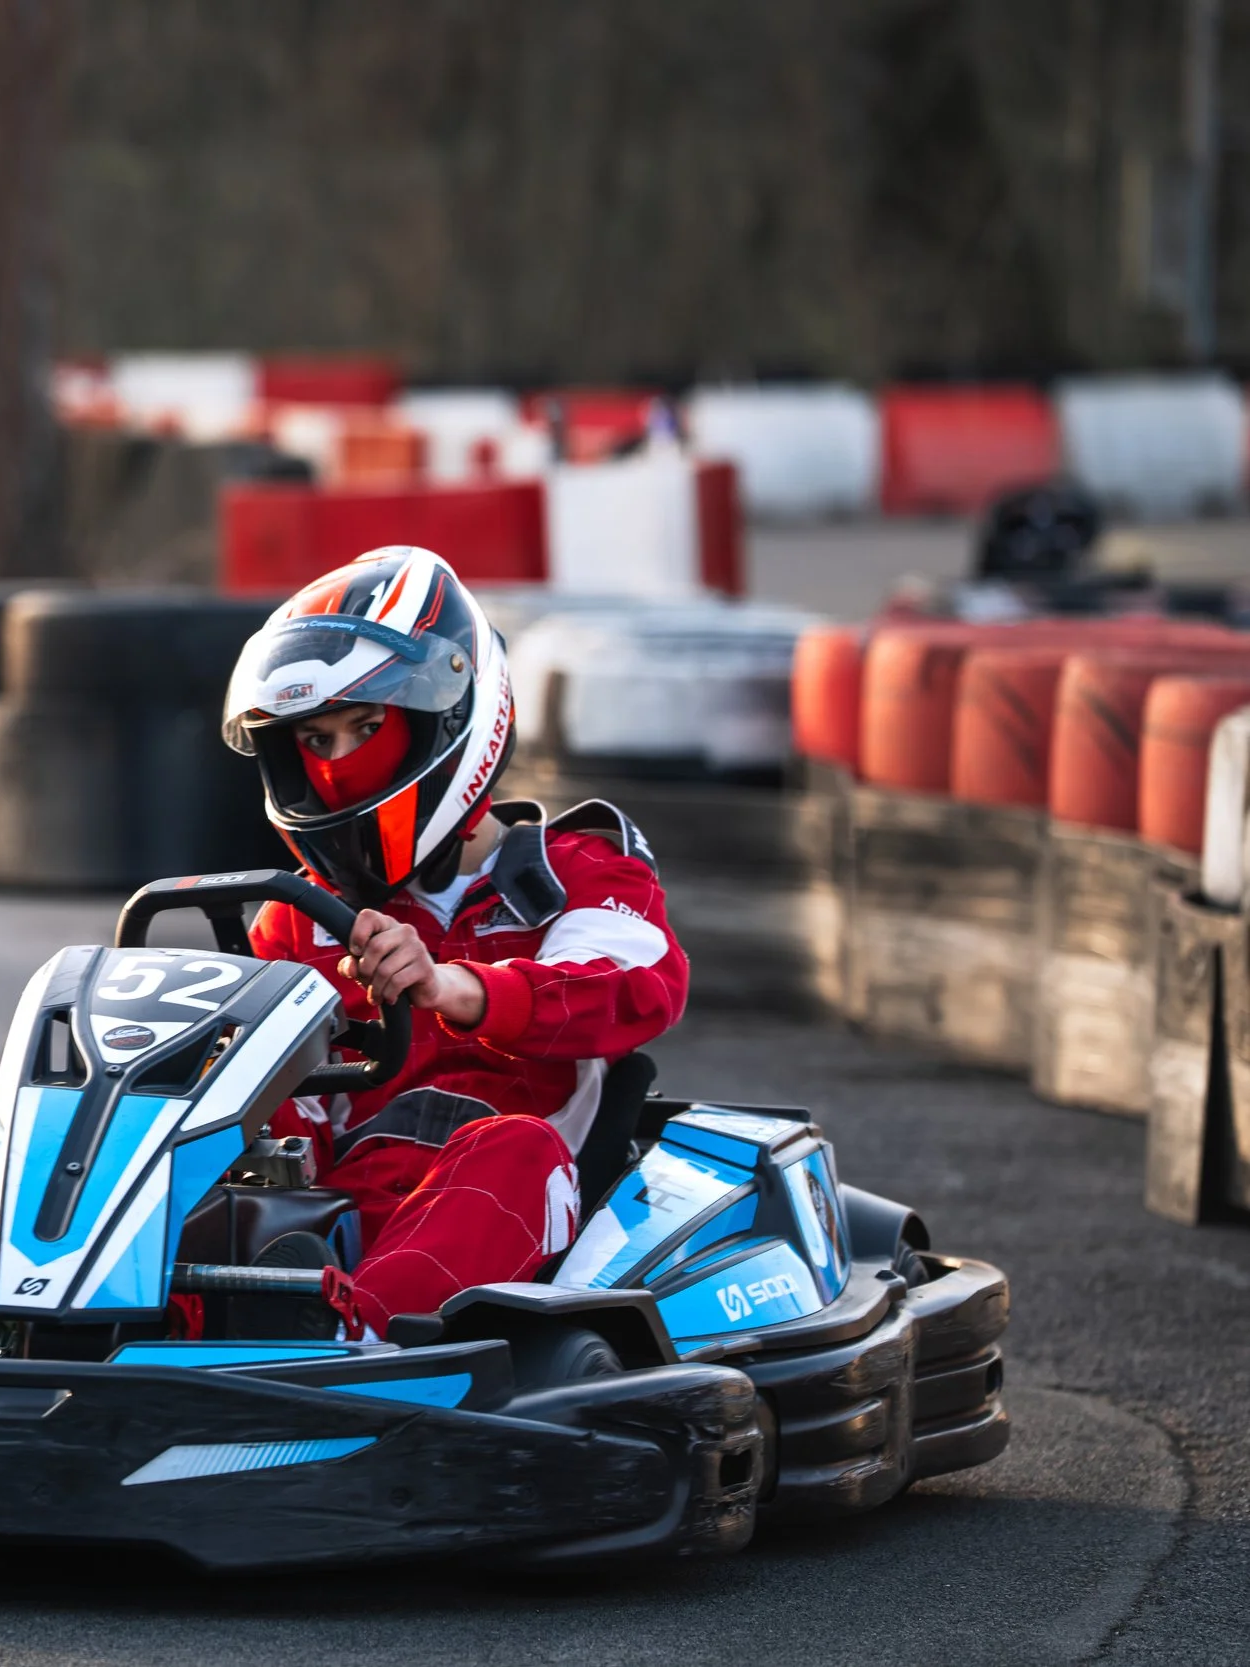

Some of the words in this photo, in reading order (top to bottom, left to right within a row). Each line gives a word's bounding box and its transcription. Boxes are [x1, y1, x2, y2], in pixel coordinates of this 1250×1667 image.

[197, 874, 247, 886] SODI
[97, 956, 243, 1012] 52
[745, 1273, 800, 1306] SODI
